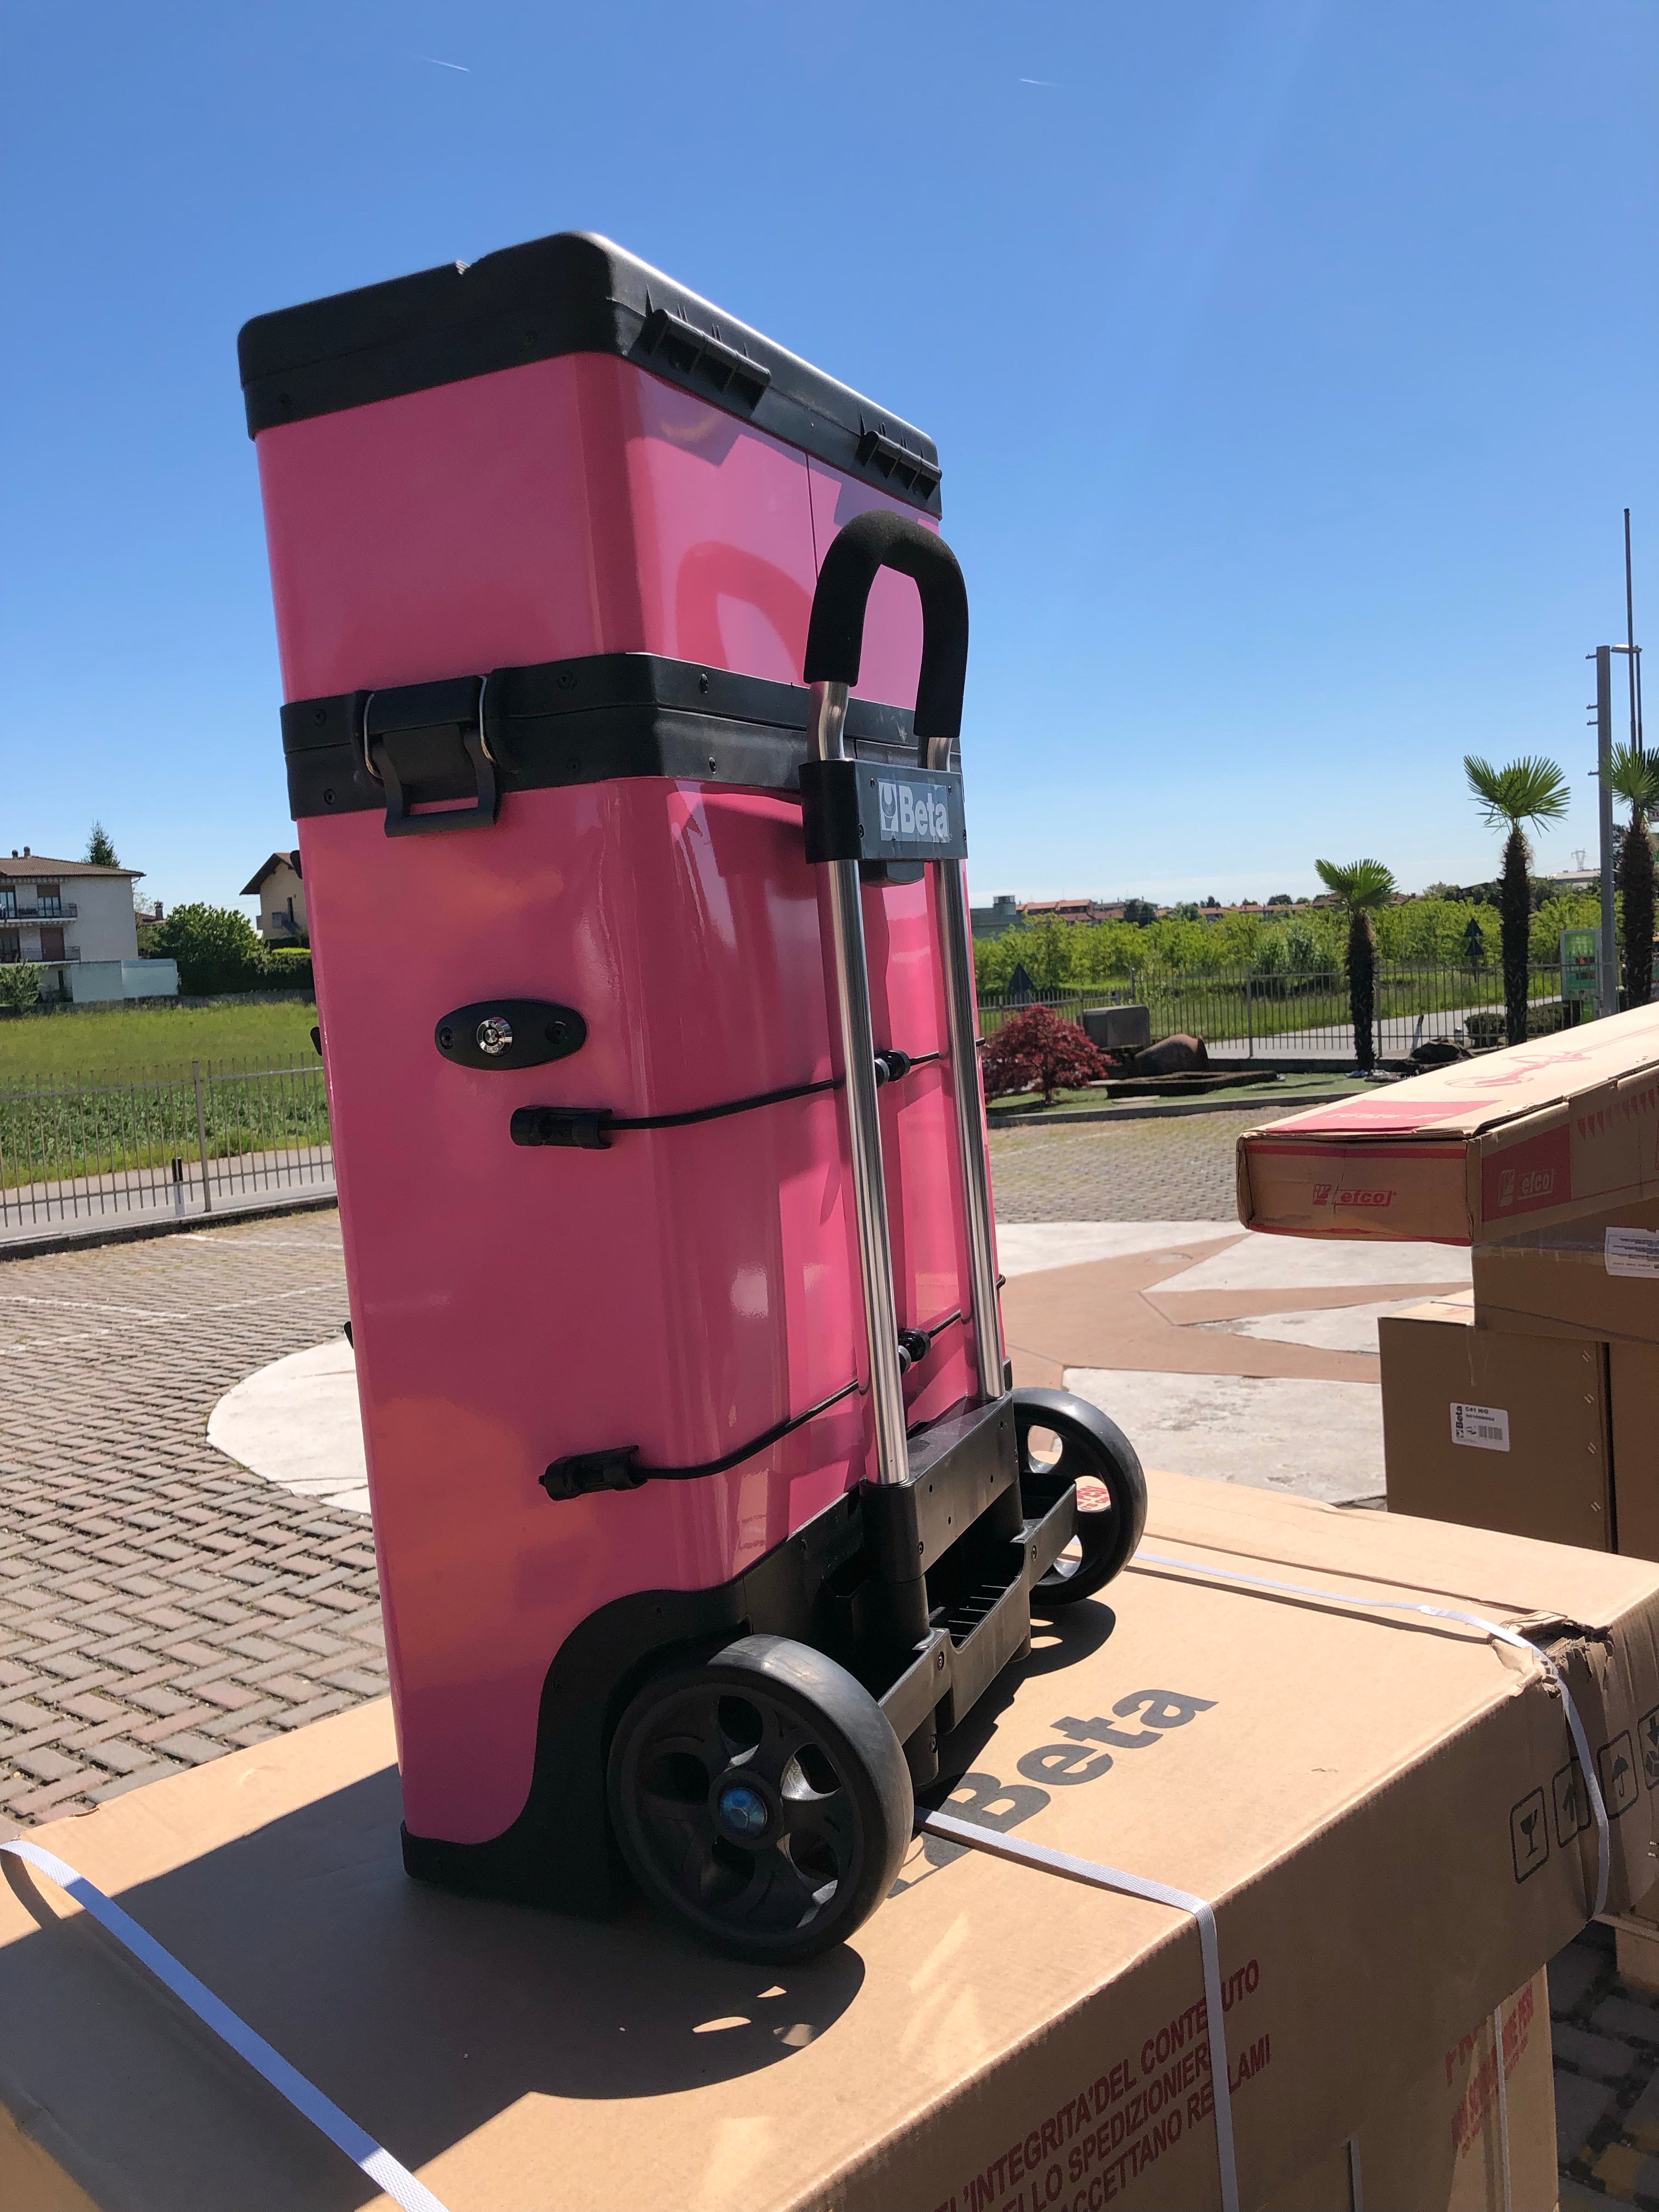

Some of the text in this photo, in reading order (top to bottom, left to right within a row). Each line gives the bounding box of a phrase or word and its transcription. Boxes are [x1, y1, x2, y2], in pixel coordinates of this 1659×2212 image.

[899, 785, 949, 838] Beta
[1341, 1189, 1385, 1204] efco
[1522, 1171, 1550, 1194] efco
[938, 1689, 1218, 1833] Beta
[1141, 1959, 1260, 2075] CONTEUTO
[1068, 2041, 1212, 2183] SPEDIZIONIER
[1187, 2034, 1271, 2129] RELAMI
